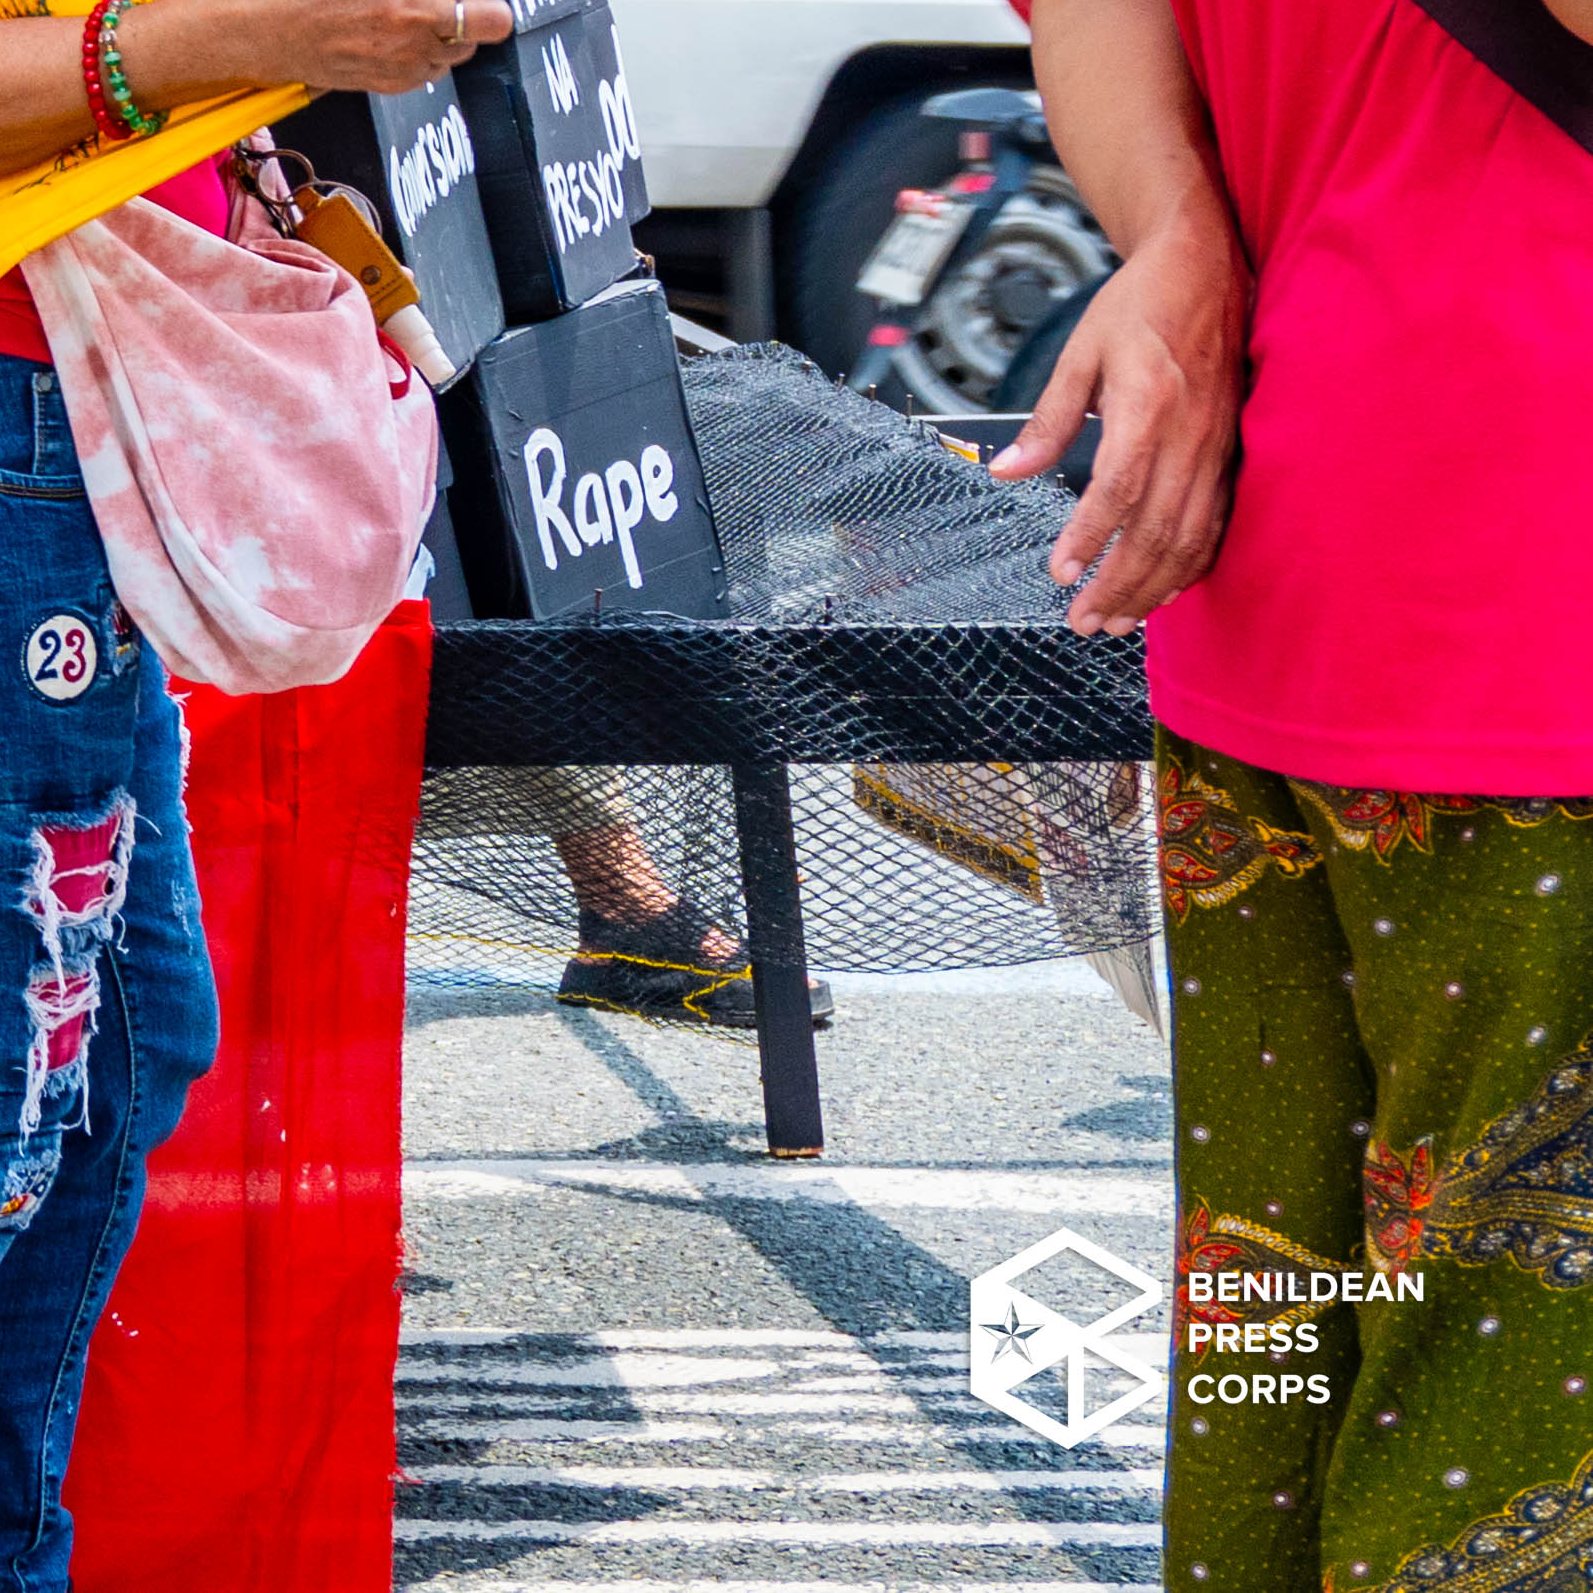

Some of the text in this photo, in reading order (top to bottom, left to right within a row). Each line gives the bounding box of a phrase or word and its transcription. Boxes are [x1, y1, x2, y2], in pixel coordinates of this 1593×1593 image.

[542, 33, 579, 115] NA
[543, 149, 624, 254] PRESYO
[523, 427, 678, 589] Rape
[34, 628, 87, 684] 23
